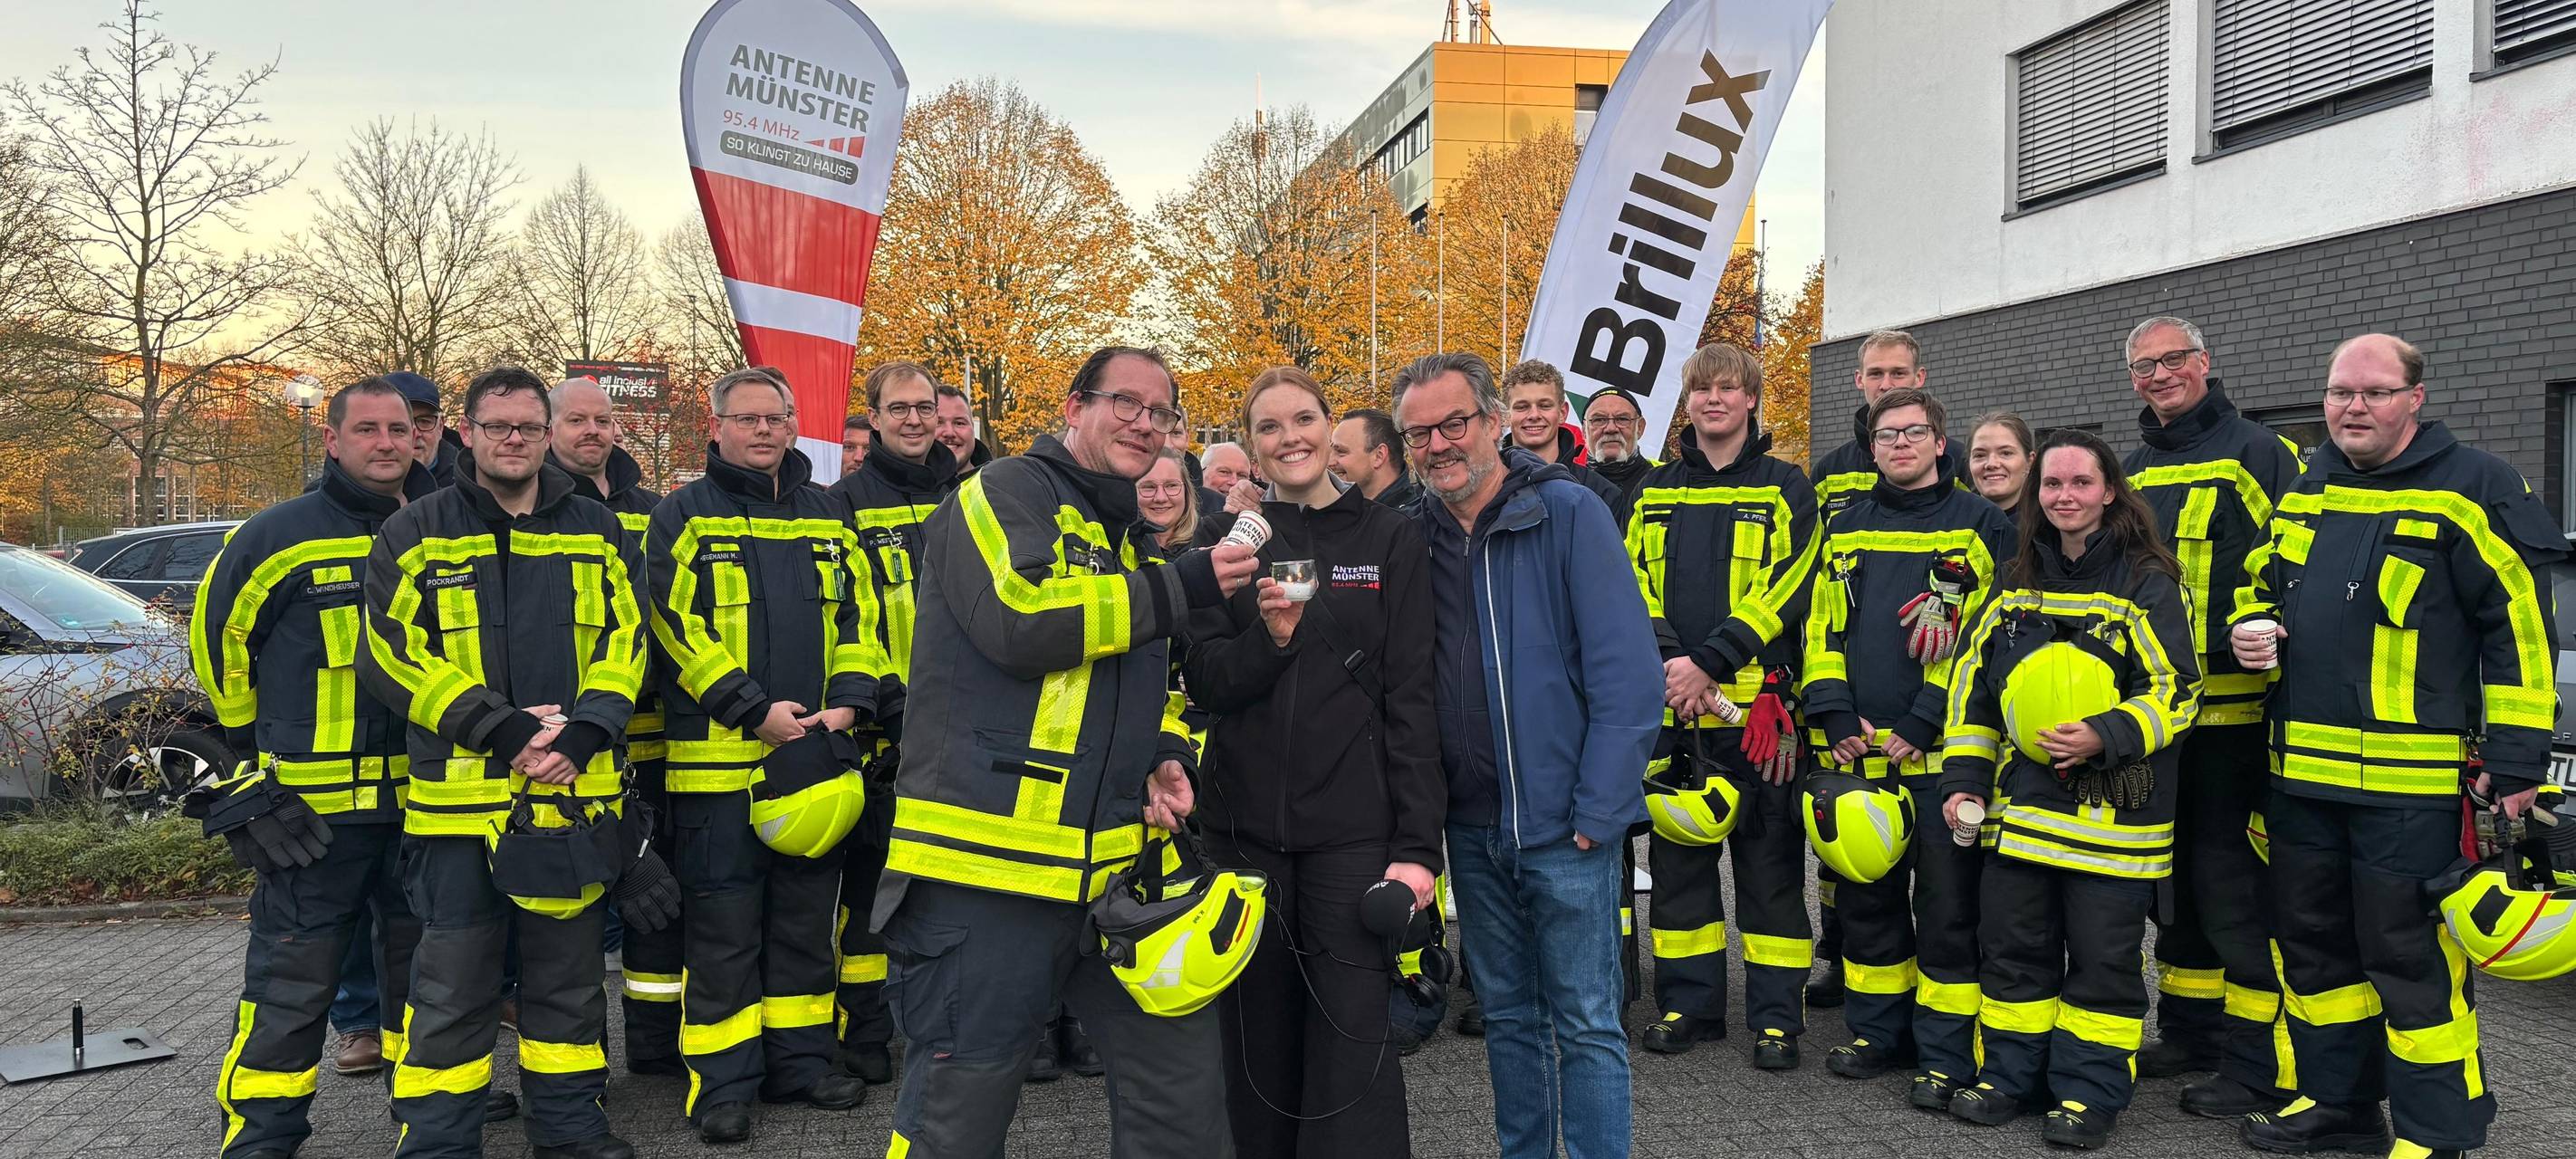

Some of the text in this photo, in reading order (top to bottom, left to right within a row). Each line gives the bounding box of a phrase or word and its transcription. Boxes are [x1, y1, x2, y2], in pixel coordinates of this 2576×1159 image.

[730, 44, 876, 105] ANTENNE
[726, 72, 870, 133] MÜNSTER
[723, 110, 800, 141] 95.4 MHz
[726, 137, 853, 179] SO KLINGT ZU HAUSE
[1570, 47, 1772, 398] Brillux
[427, 574, 468, 587] POCKRANDT
[1332, 564, 1379, 573] ANTENNE
[316, 581, 360, 594] WINDHEUSER
